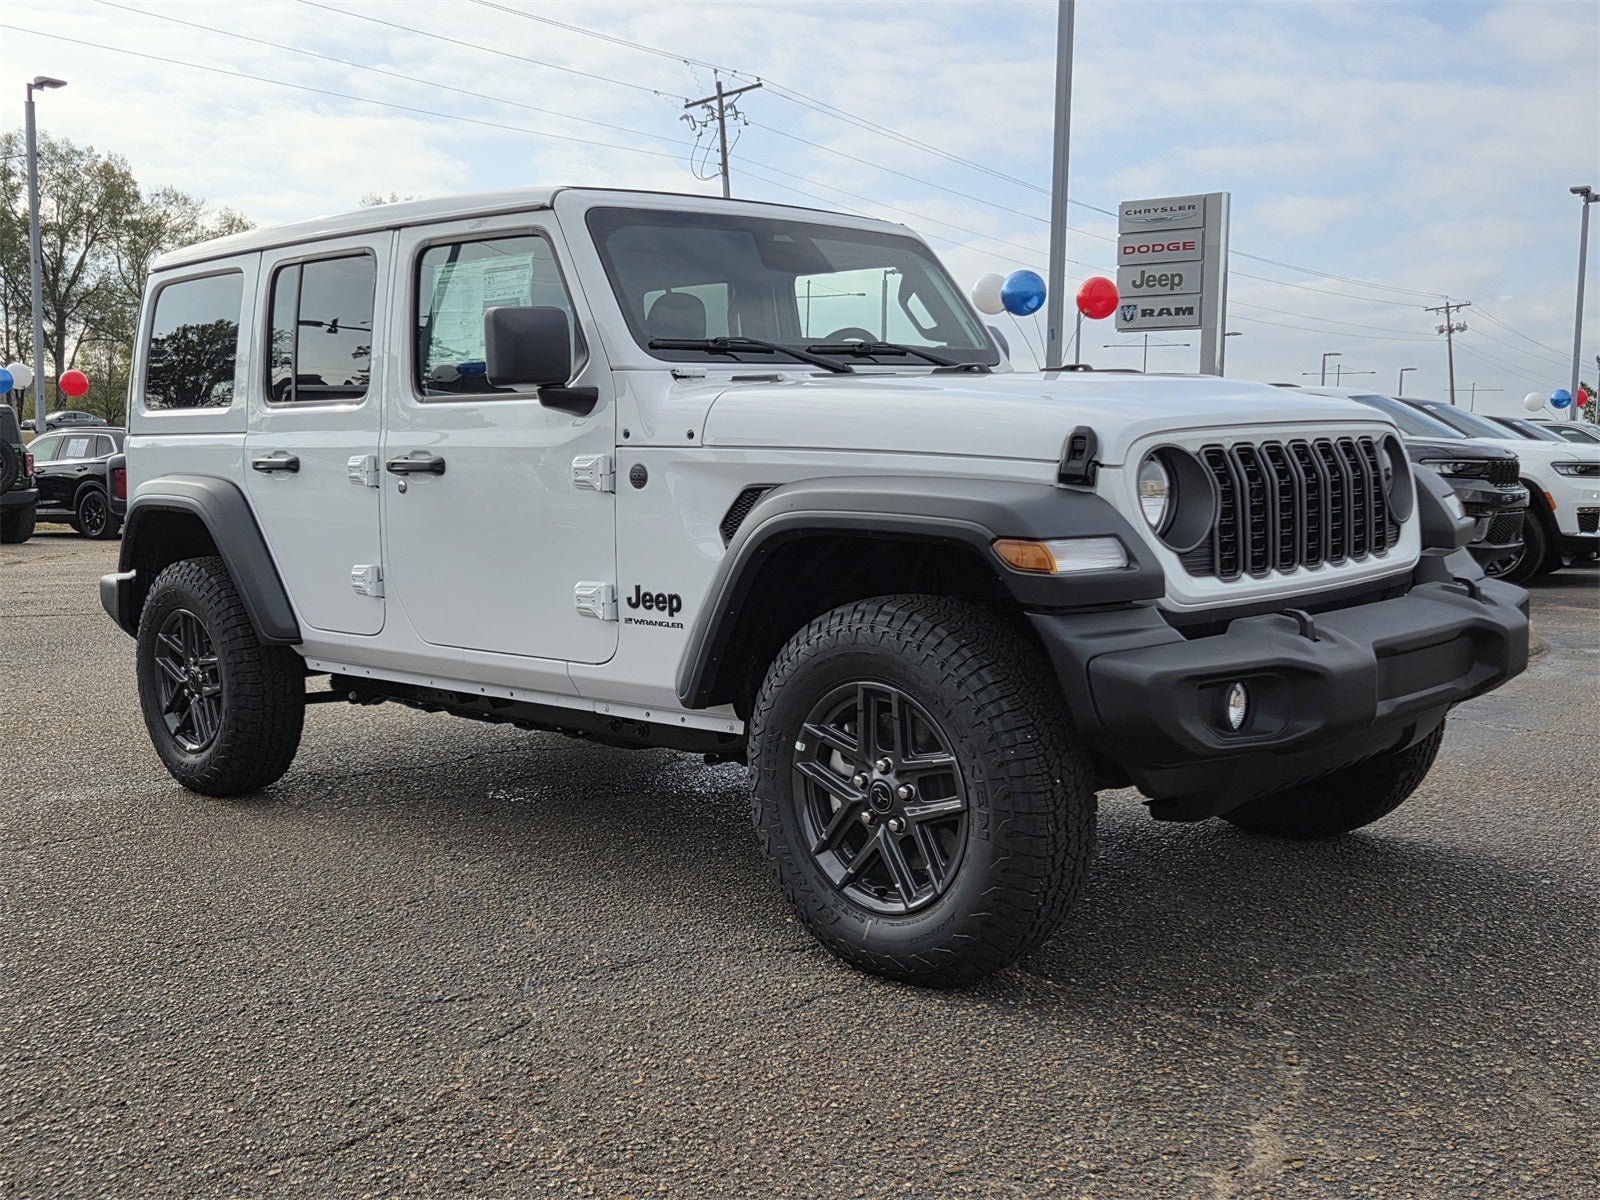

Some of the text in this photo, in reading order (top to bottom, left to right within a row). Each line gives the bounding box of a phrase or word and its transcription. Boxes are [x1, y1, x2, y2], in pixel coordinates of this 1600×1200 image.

[1125, 204, 1196, 216] CHRYSLER
[1123, 241, 1195, 255] DODGE
[1131, 270, 1184, 290] Jeep
[1140, 306, 1194, 318] RAM
[626, 584, 682, 617] Jeep
[633, 618, 684, 629] WRANGLER
